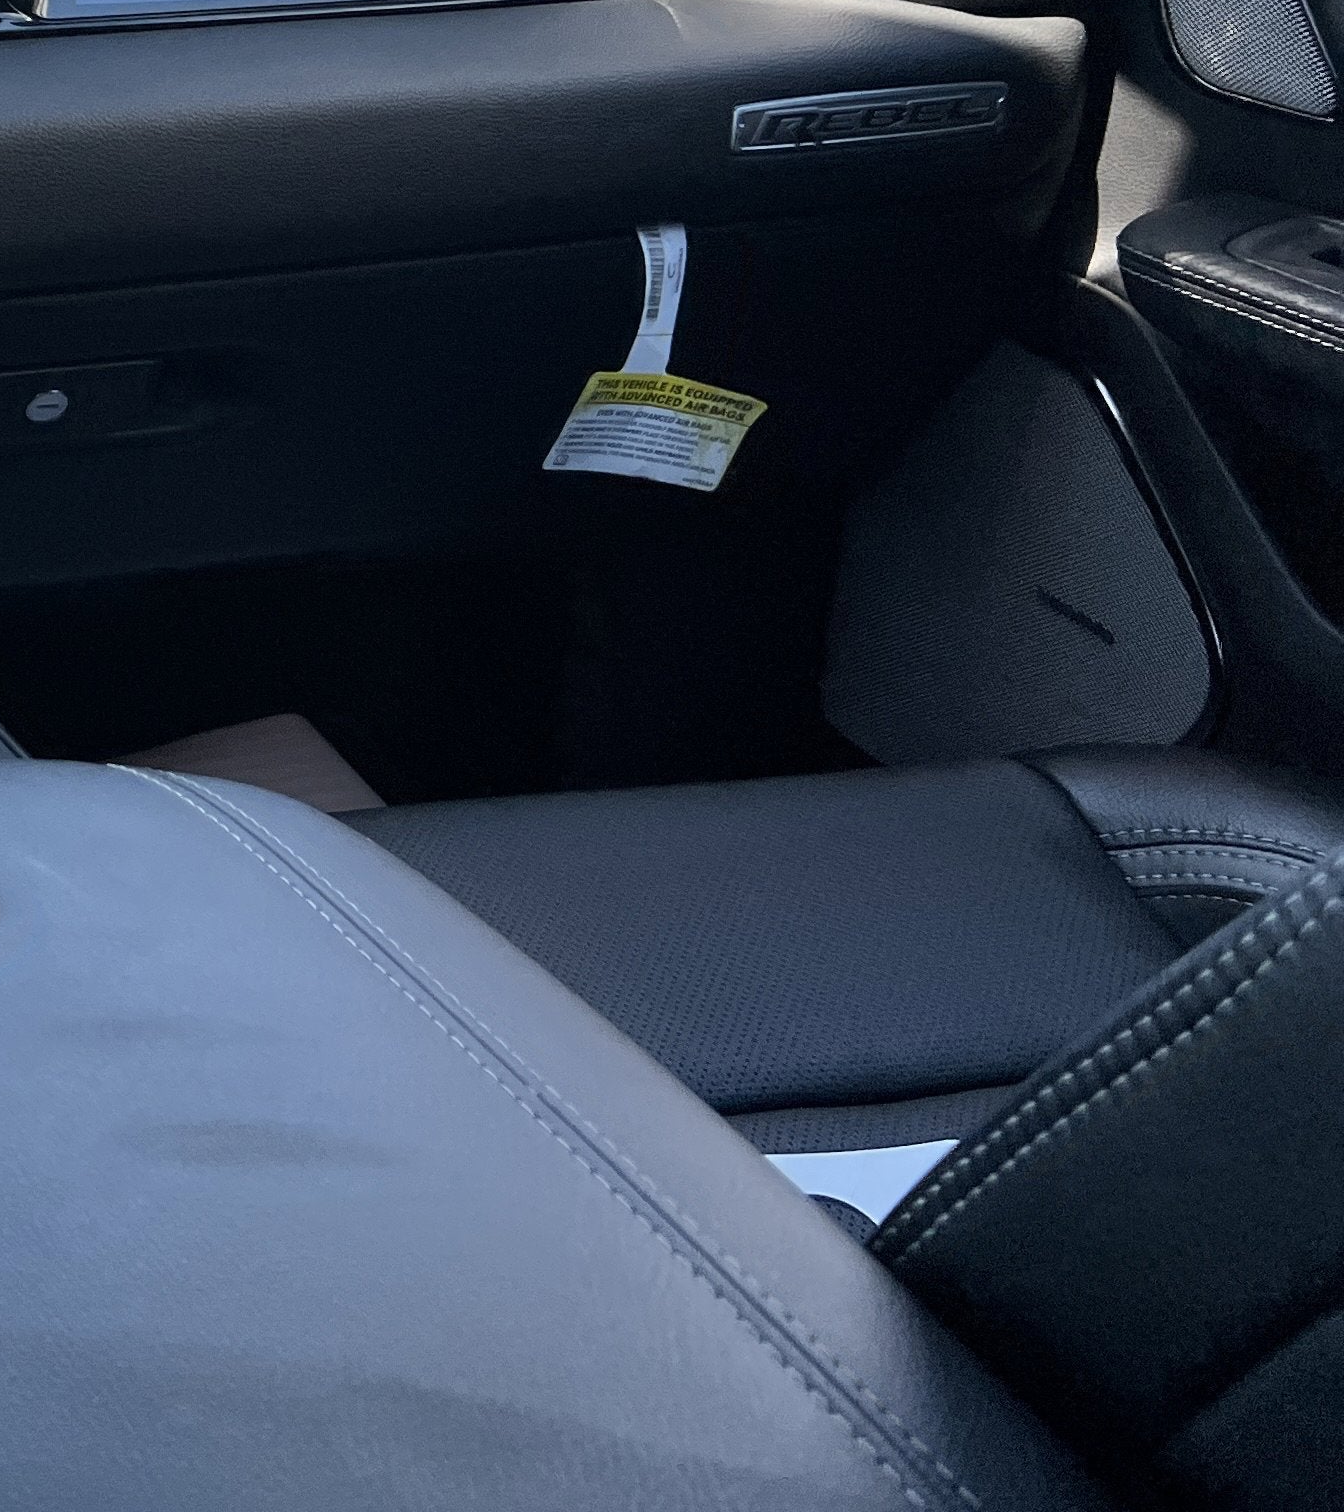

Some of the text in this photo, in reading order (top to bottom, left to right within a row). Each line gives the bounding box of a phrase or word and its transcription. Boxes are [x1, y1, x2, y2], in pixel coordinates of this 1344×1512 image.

[749, 92, 992, 145] REBEL
[590, 390, 747, 422] WITH ADVANCED AIR BAGS
[597, 378, 755, 412] THIS VEHICLE IS EQUIPPED
[632, 409, 675, 424] ADVANCED
